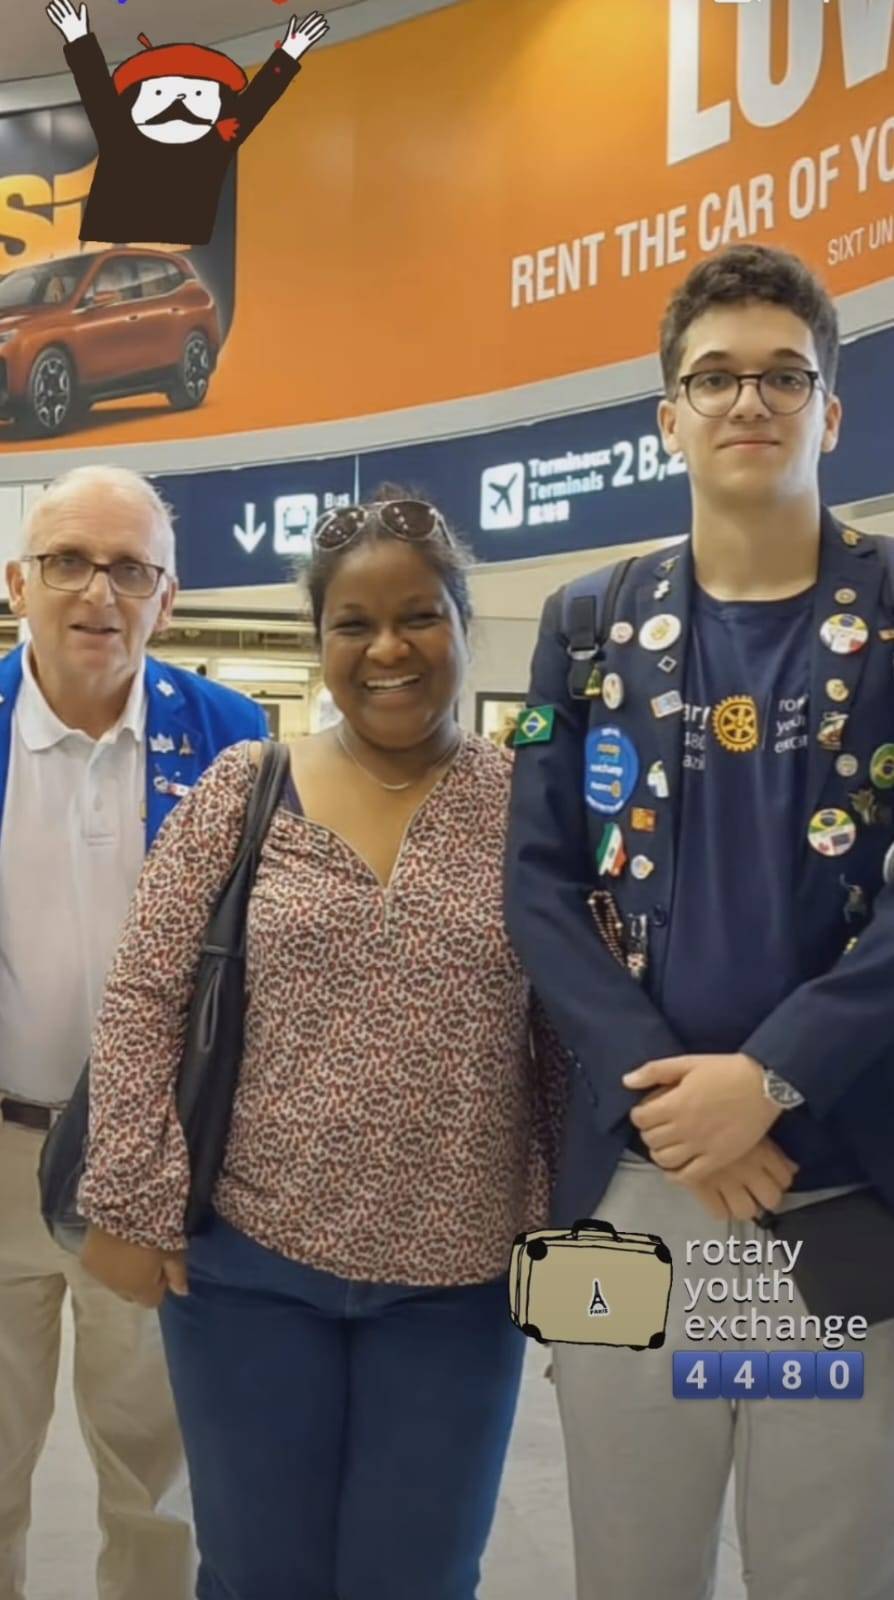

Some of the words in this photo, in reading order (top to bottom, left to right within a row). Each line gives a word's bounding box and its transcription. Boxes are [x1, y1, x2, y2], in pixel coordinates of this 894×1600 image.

[511, 232, 605, 309] RENT
[615, 205, 687, 278] THE
[698, 173, 775, 252] CAR
[788, 144, 841, 220] OF
[850, 116, 894, 193] YO
[827, 226, 865, 266] SIXT
[528, 449, 611, 479] Terminaux
[324, 492, 350, 509] Bus
[528, 470, 604, 501] Terminals
